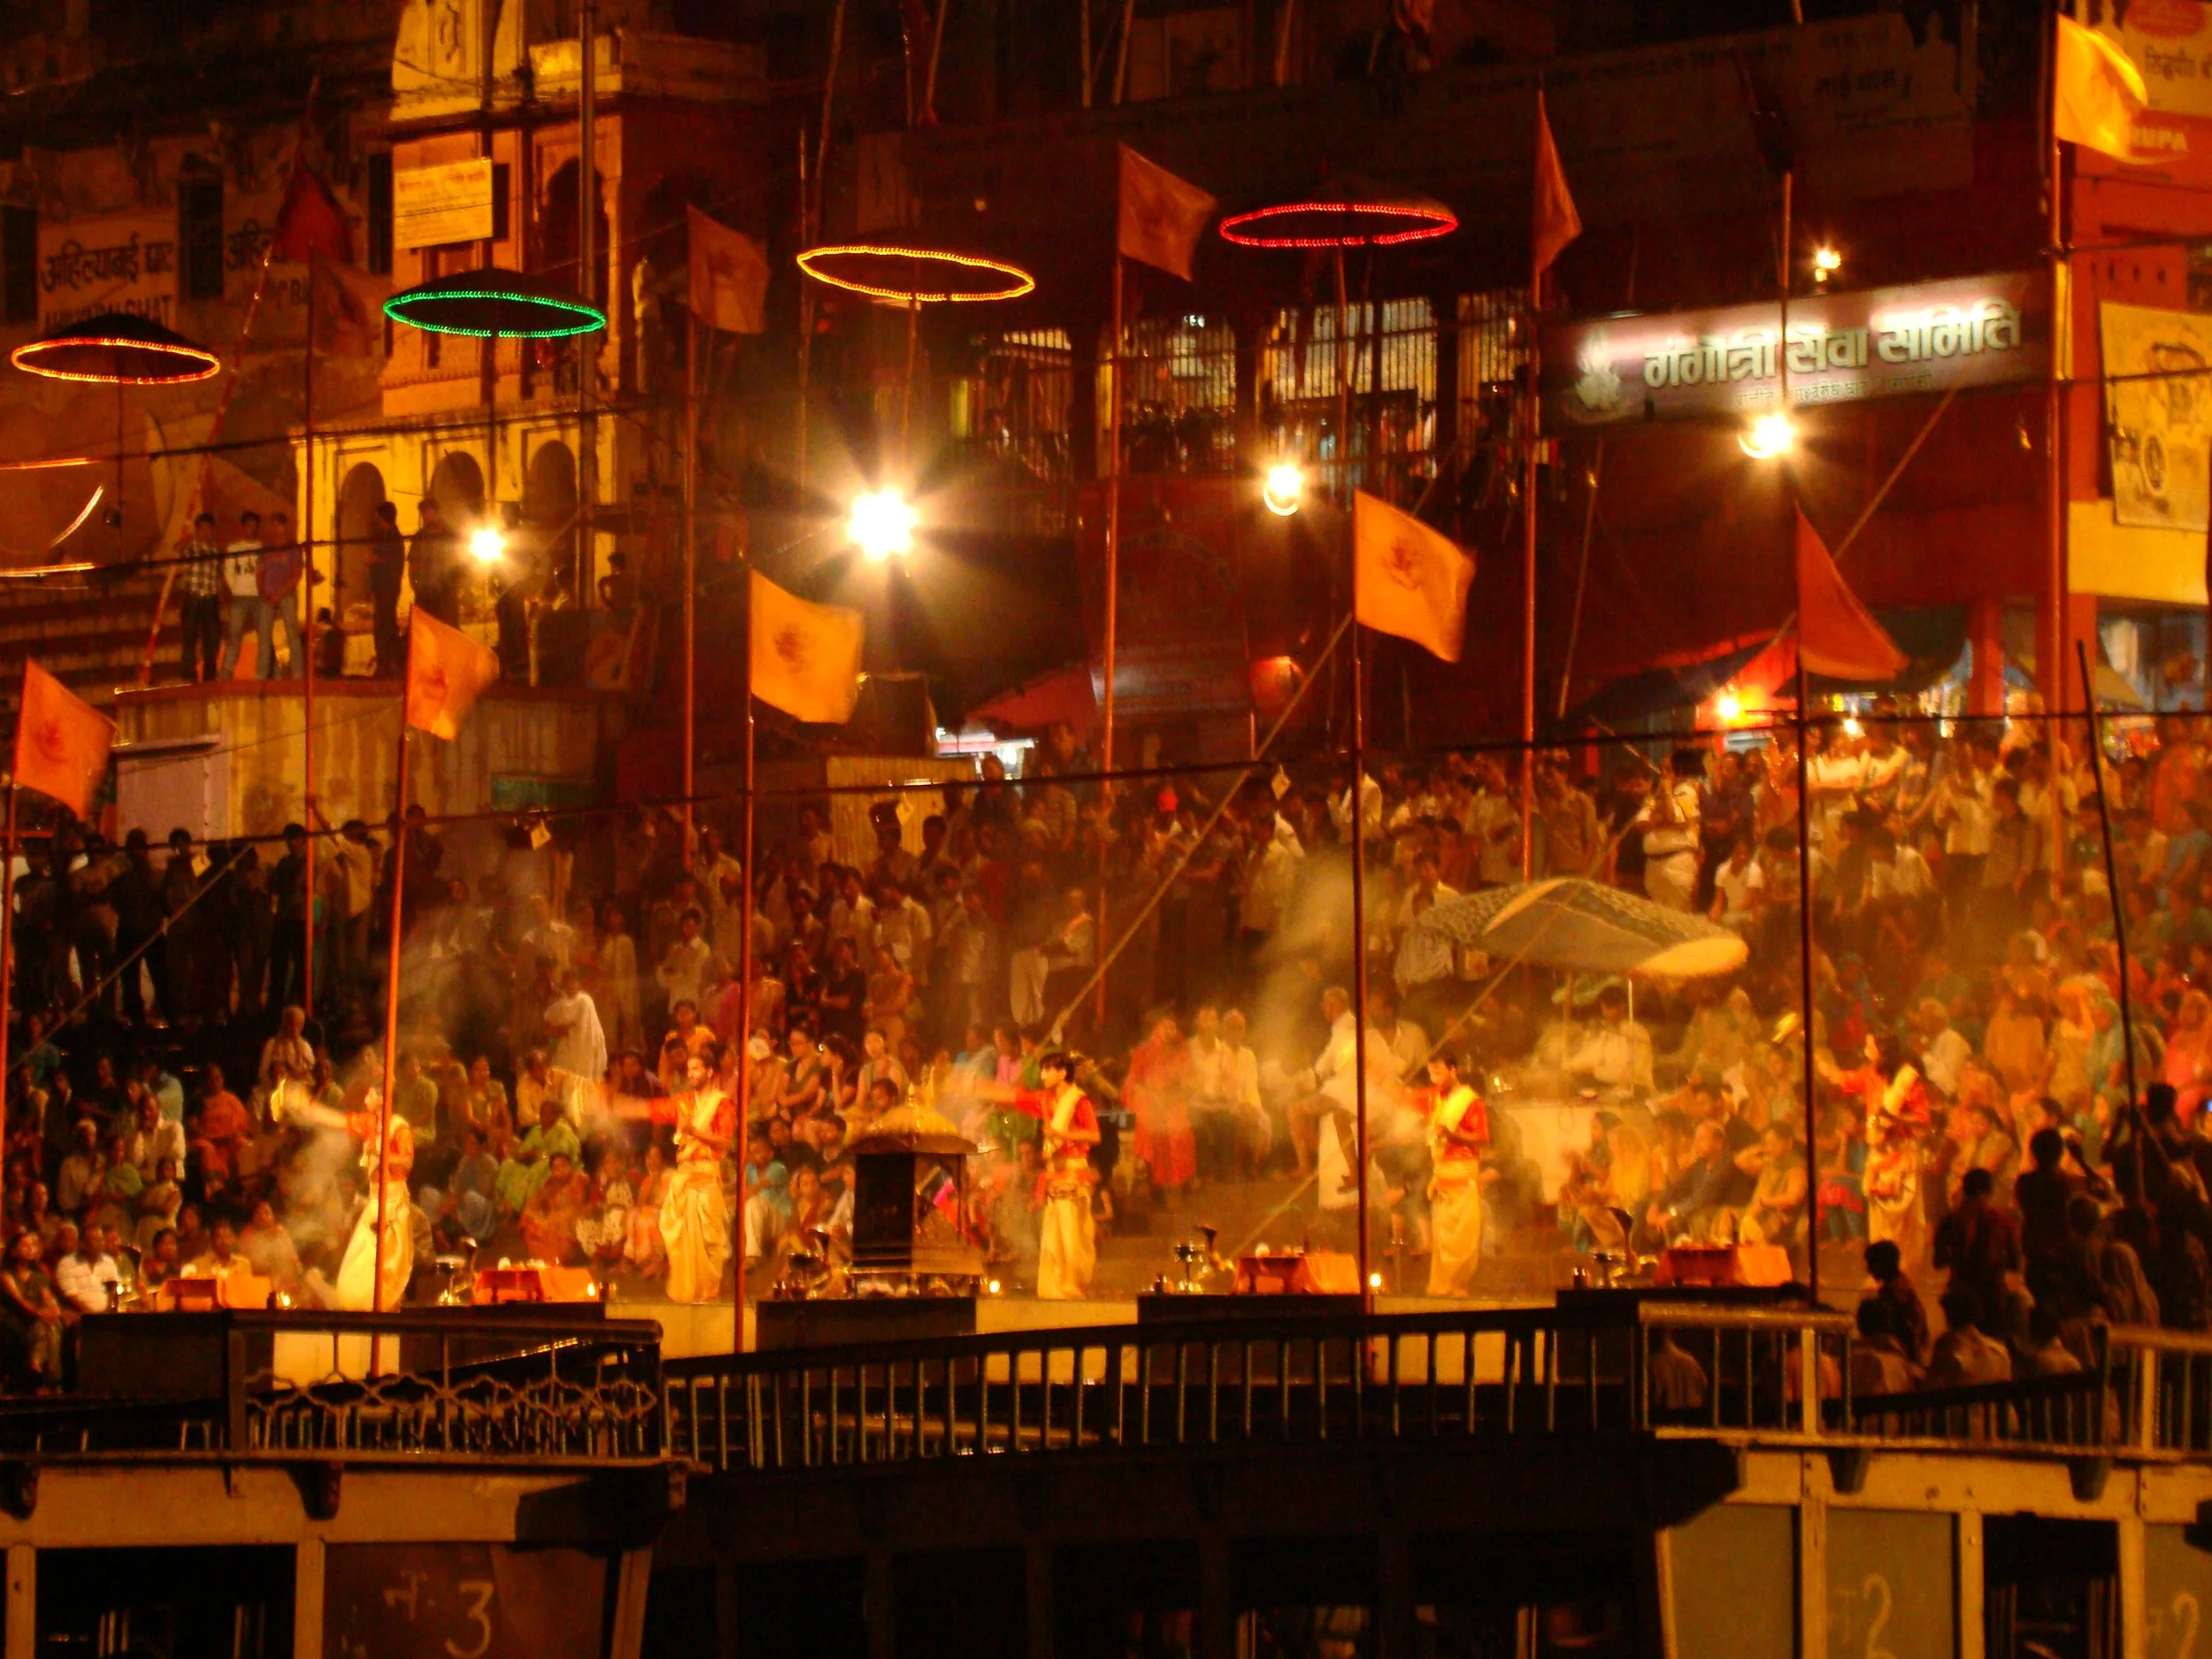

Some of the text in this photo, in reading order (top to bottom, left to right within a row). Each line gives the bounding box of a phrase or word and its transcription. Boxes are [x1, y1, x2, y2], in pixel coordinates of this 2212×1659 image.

[1643, 297, 2023, 388] गंगोत्री सेवा समिति
[444, 1578, 495, 1659] 3
